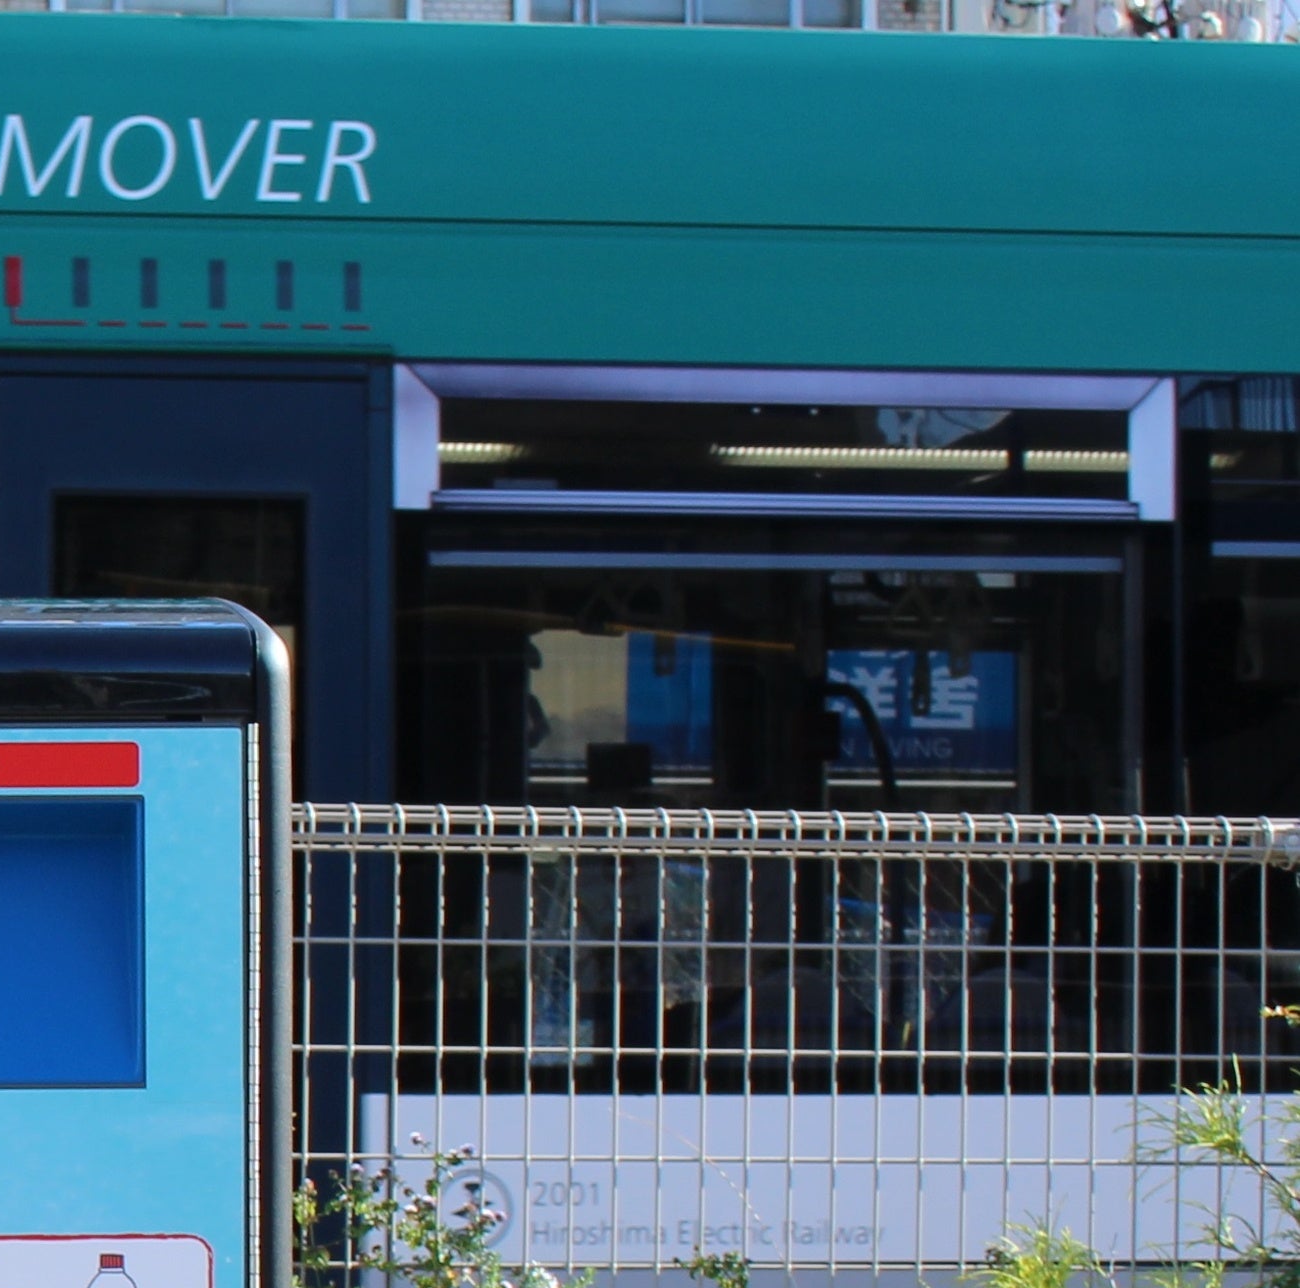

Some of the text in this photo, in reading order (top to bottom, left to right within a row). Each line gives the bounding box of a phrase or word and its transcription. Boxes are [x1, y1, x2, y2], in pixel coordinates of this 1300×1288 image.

[532, 1180, 600, 1207] 2001
[530, 1219, 667, 1246] Hiroshima
[783, 1219, 886, 1252] Railway
